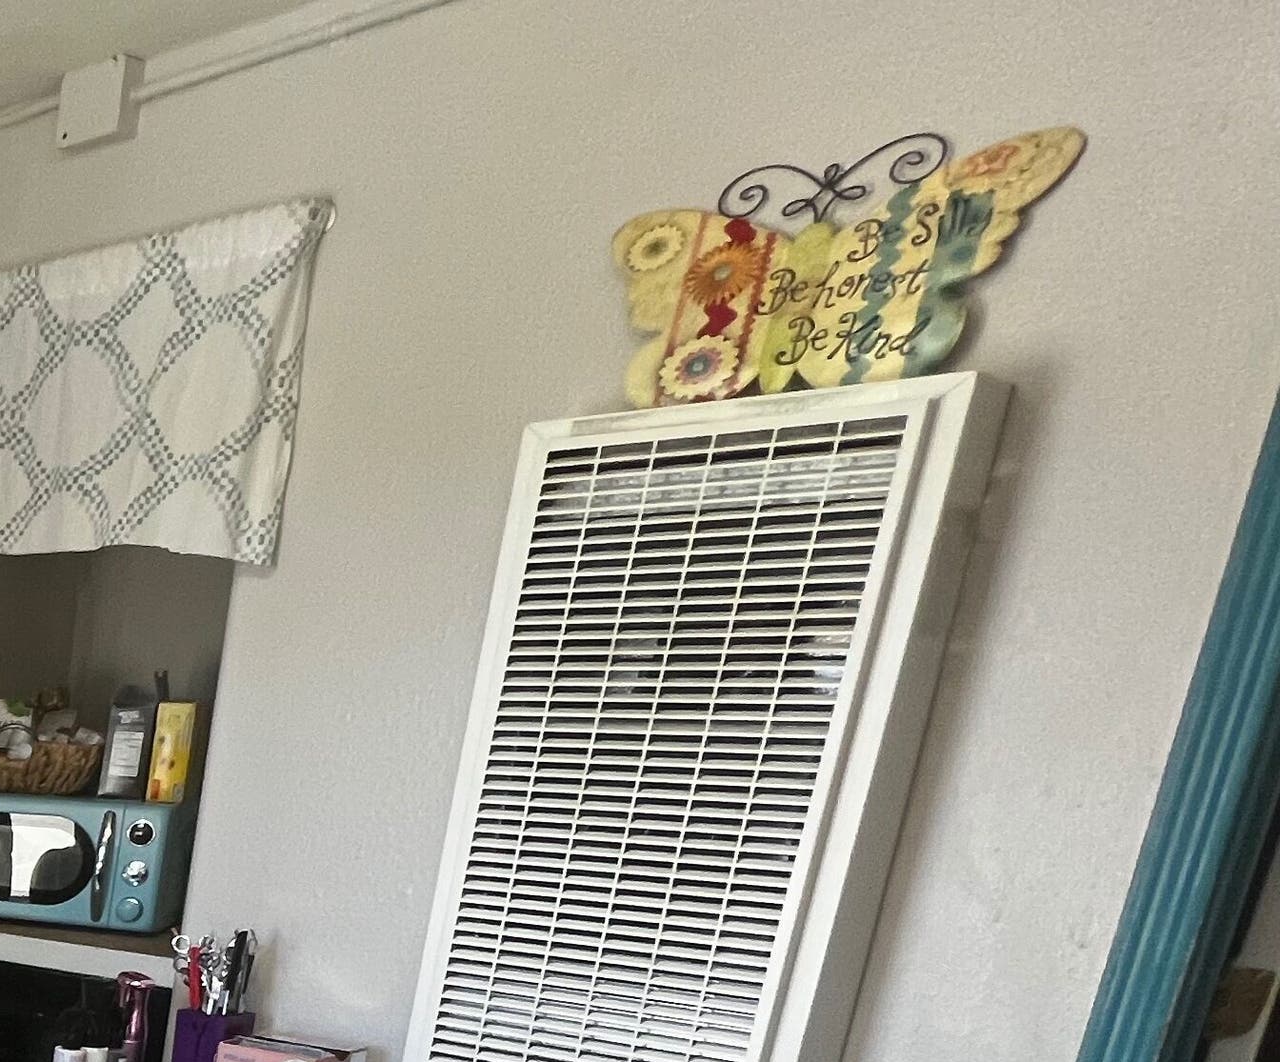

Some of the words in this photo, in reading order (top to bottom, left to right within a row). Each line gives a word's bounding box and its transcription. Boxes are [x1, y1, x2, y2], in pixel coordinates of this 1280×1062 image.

[846, 218, 904, 263] Be
[757, 268, 809, 315] Be
[811, 259, 932, 309] honest
[774, 315, 829, 366] Be
